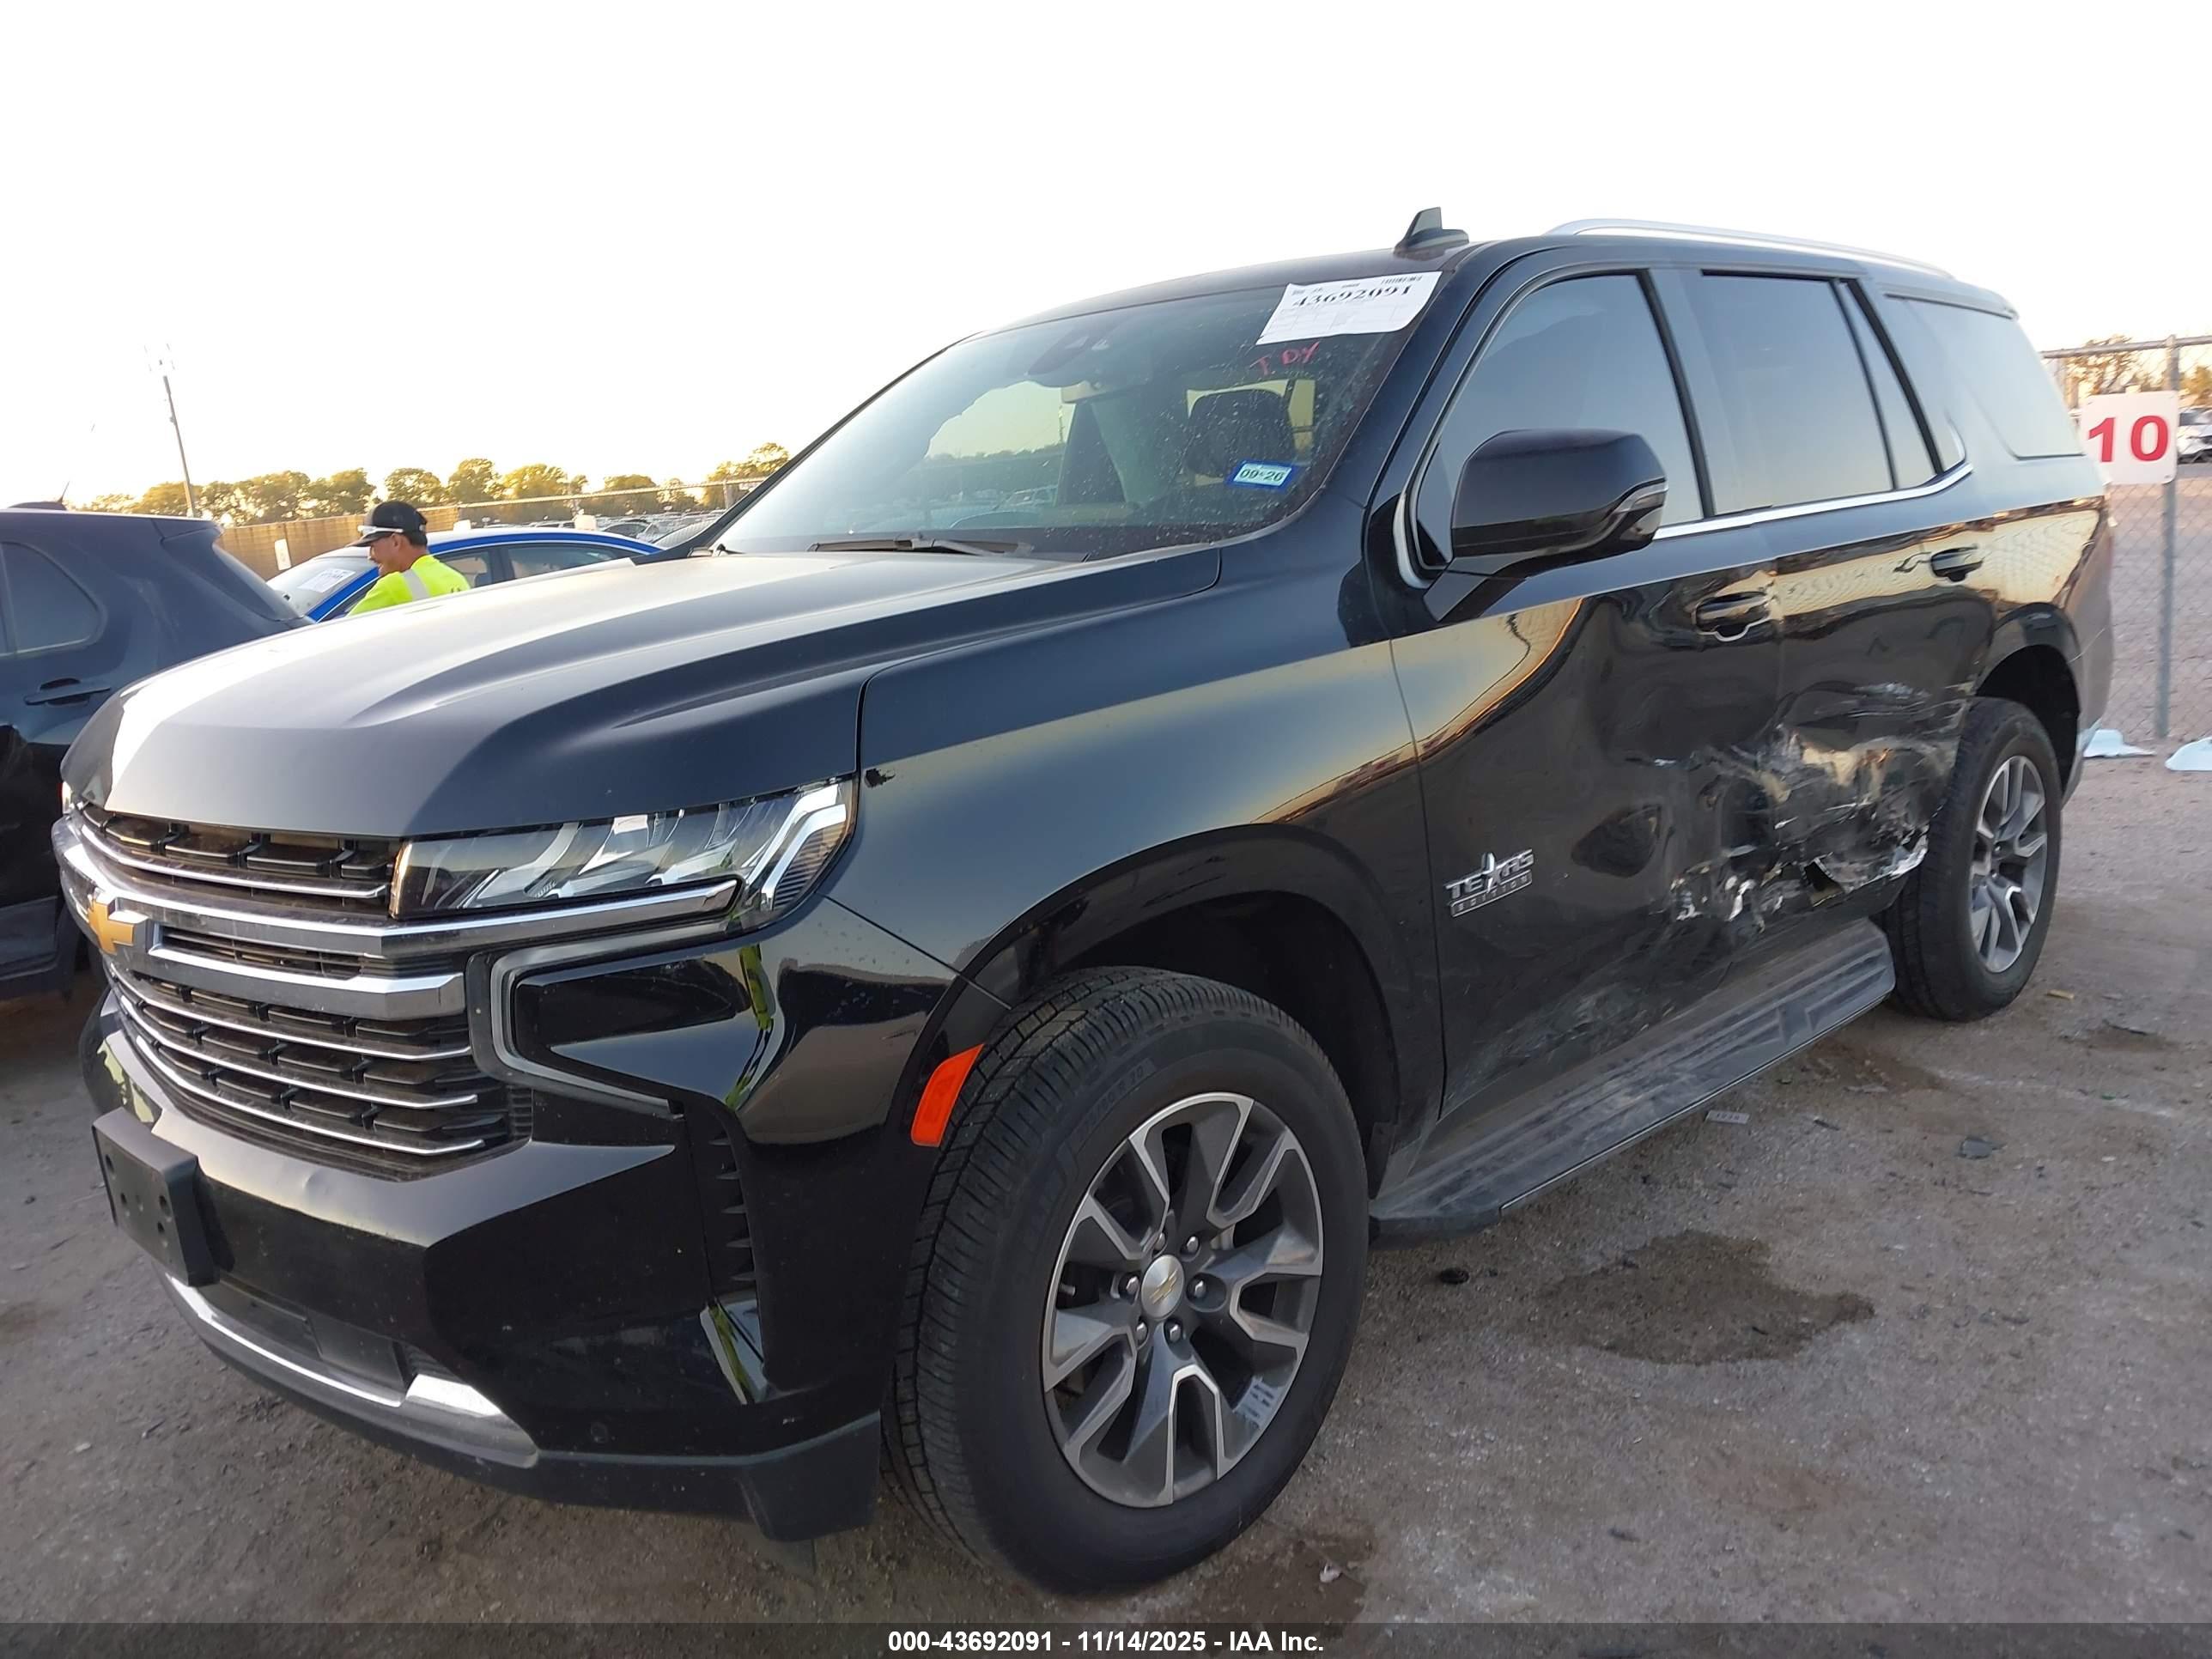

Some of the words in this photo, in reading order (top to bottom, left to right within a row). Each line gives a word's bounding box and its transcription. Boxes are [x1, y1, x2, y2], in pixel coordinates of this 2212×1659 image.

[1292, 285, 1413, 307] 43692091
[2088, 415, 2169, 463] 10
[1445, 848, 1534, 900] TEXAS
